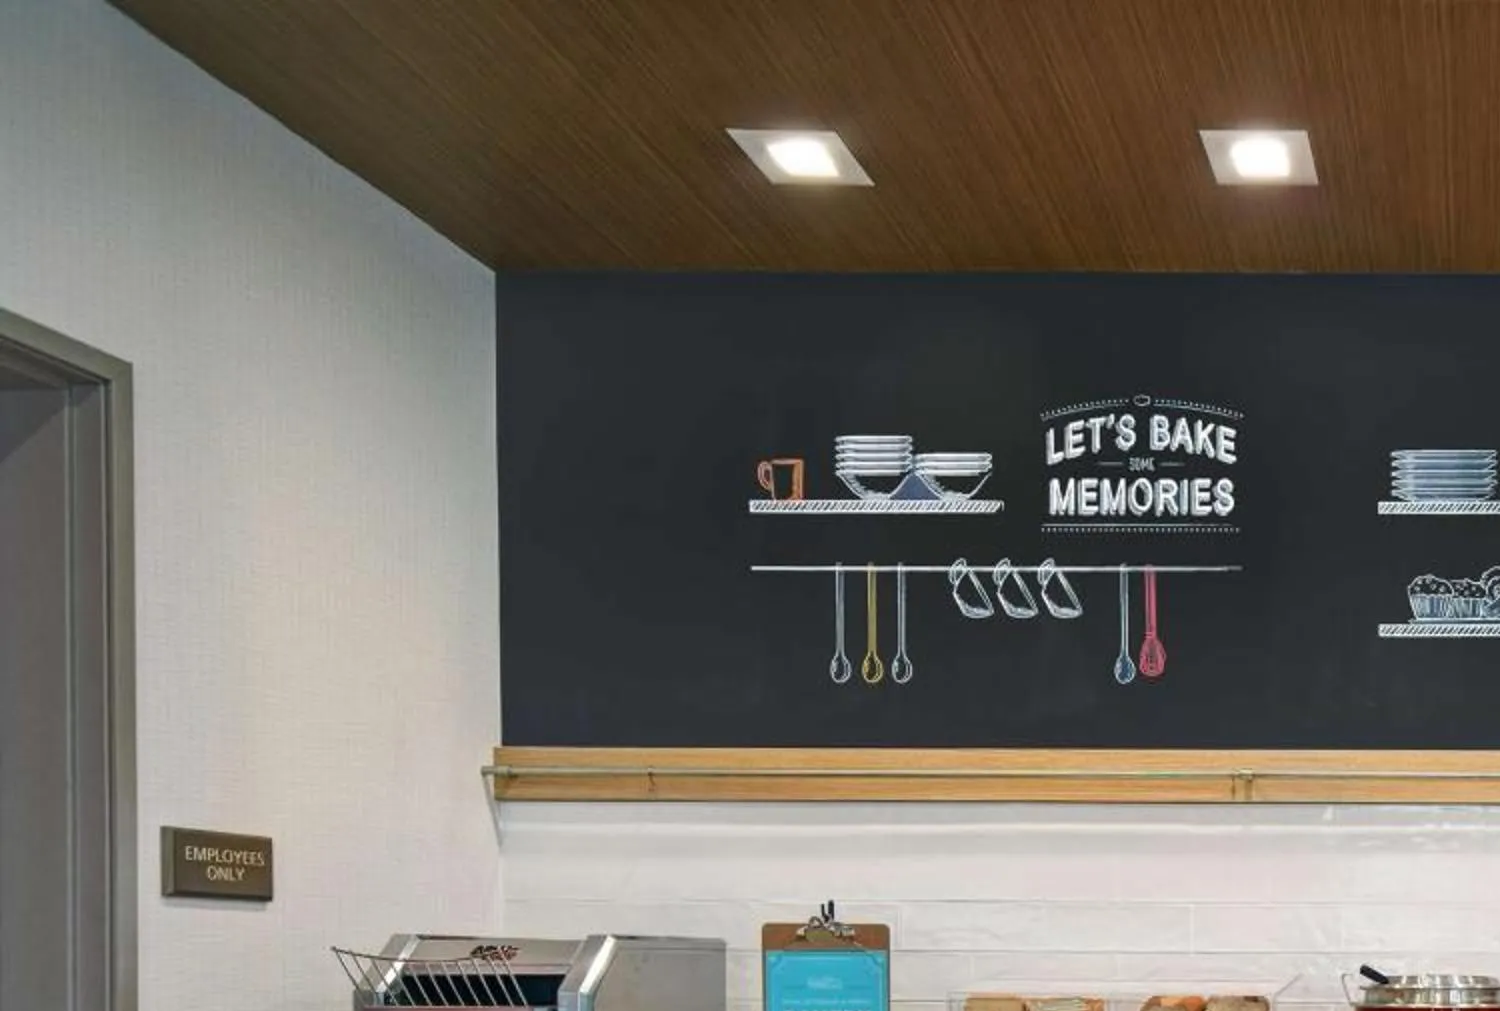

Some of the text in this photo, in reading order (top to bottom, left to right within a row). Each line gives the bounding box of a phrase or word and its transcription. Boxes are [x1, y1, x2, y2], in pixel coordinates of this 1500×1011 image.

[1046, 413, 1238, 465] LET'S BAKE
[1129, 457, 1156, 471] SOME
[1048, 477, 1236, 516] MEMORIES
[184, 845, 265, 867] EMPLOYEES
[207, 865, 245, 882] ONLY
